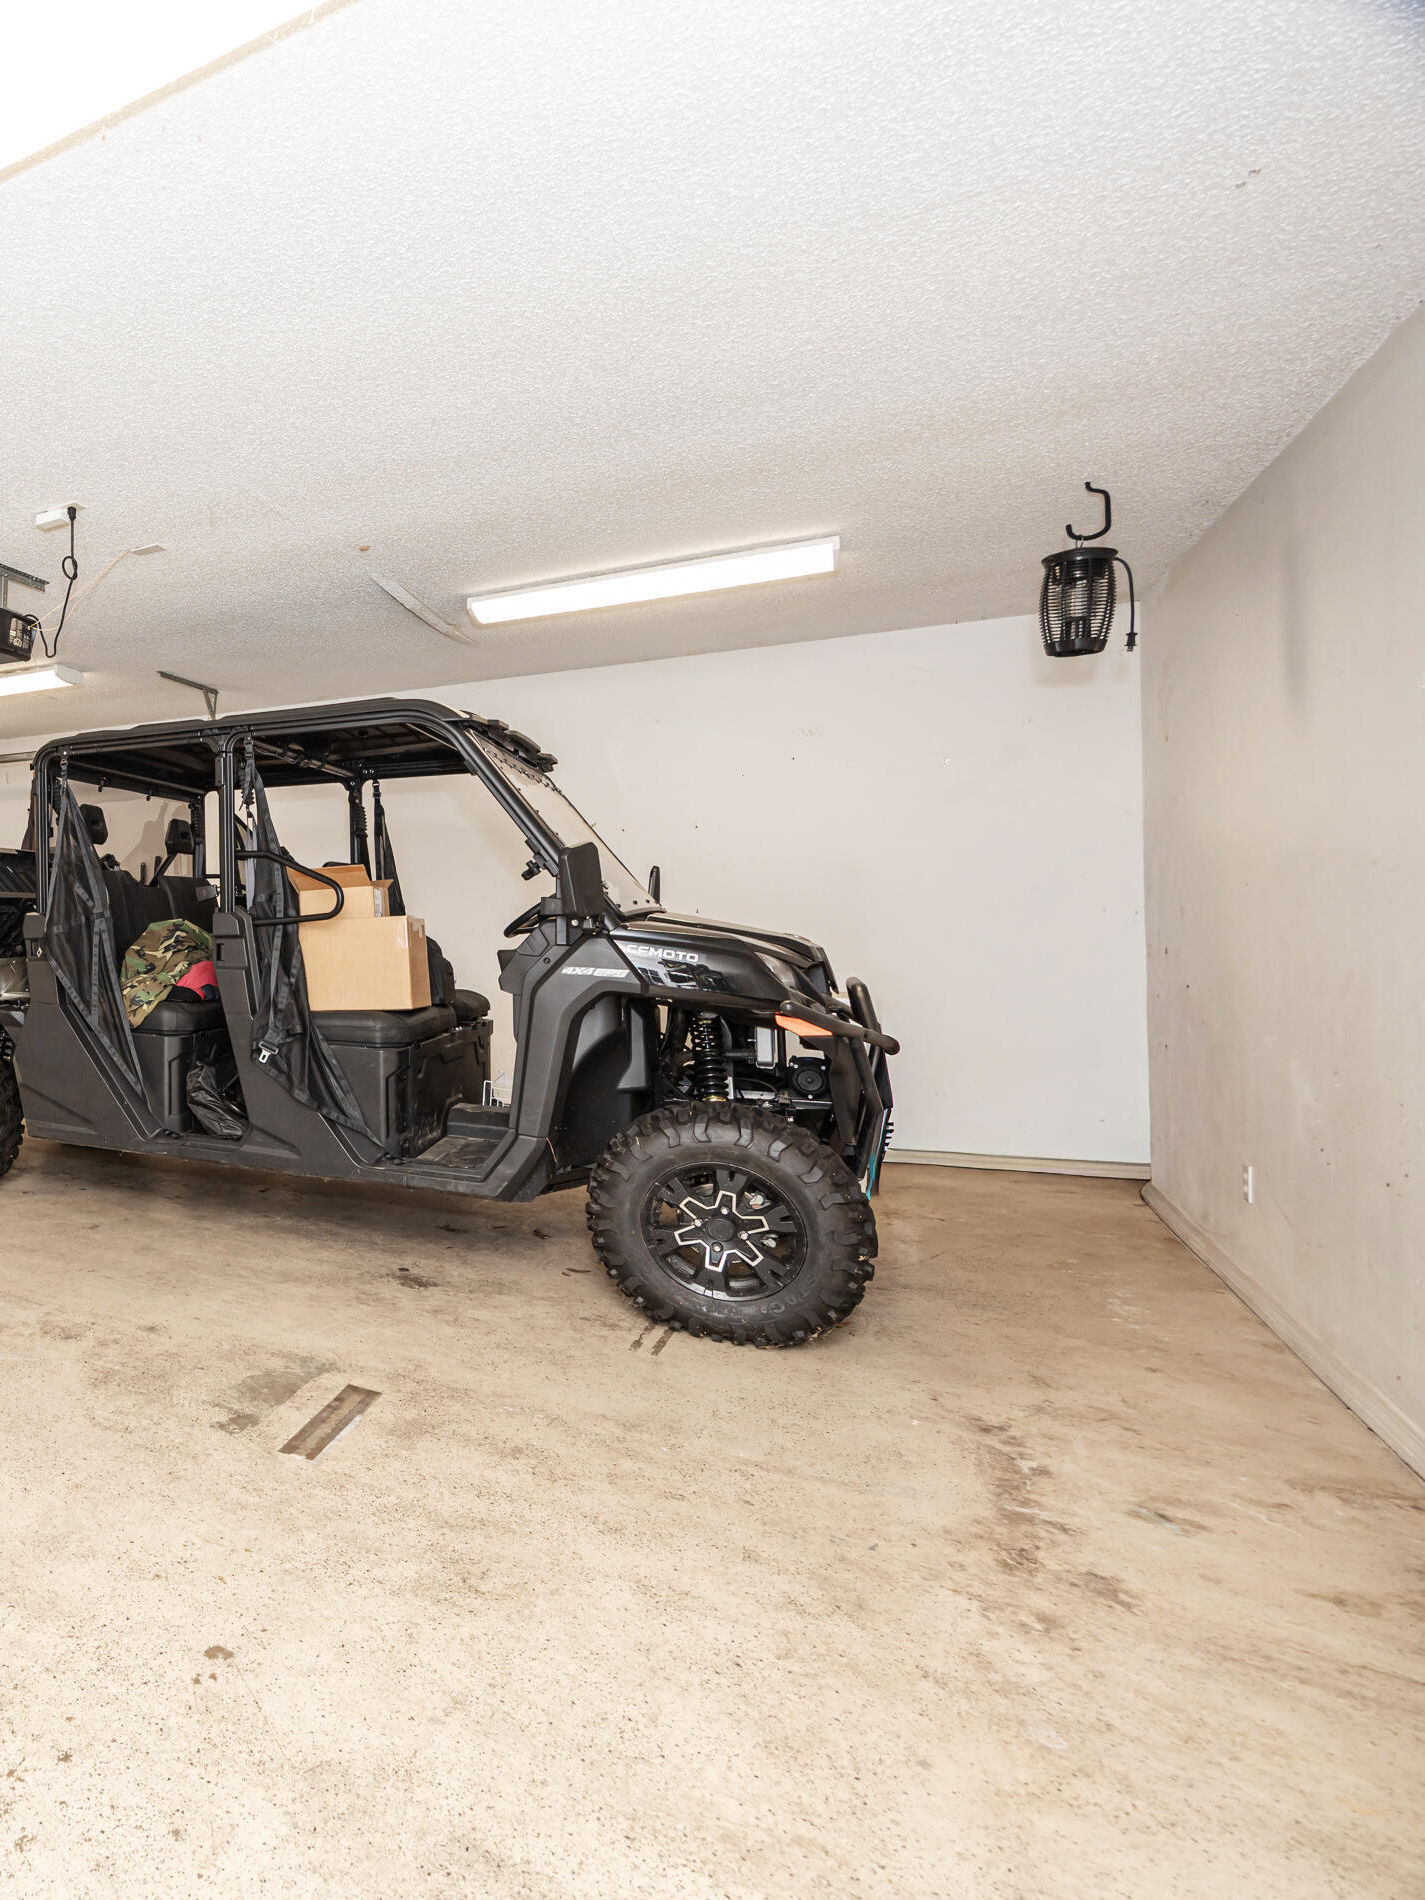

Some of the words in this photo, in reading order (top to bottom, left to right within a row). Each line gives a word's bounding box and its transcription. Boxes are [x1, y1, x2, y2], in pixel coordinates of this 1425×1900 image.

[626, 944, 699, 962] CFMOTO
[561, 965, 593, 976] 4X4
[593, 967, 630, 978] EPS
